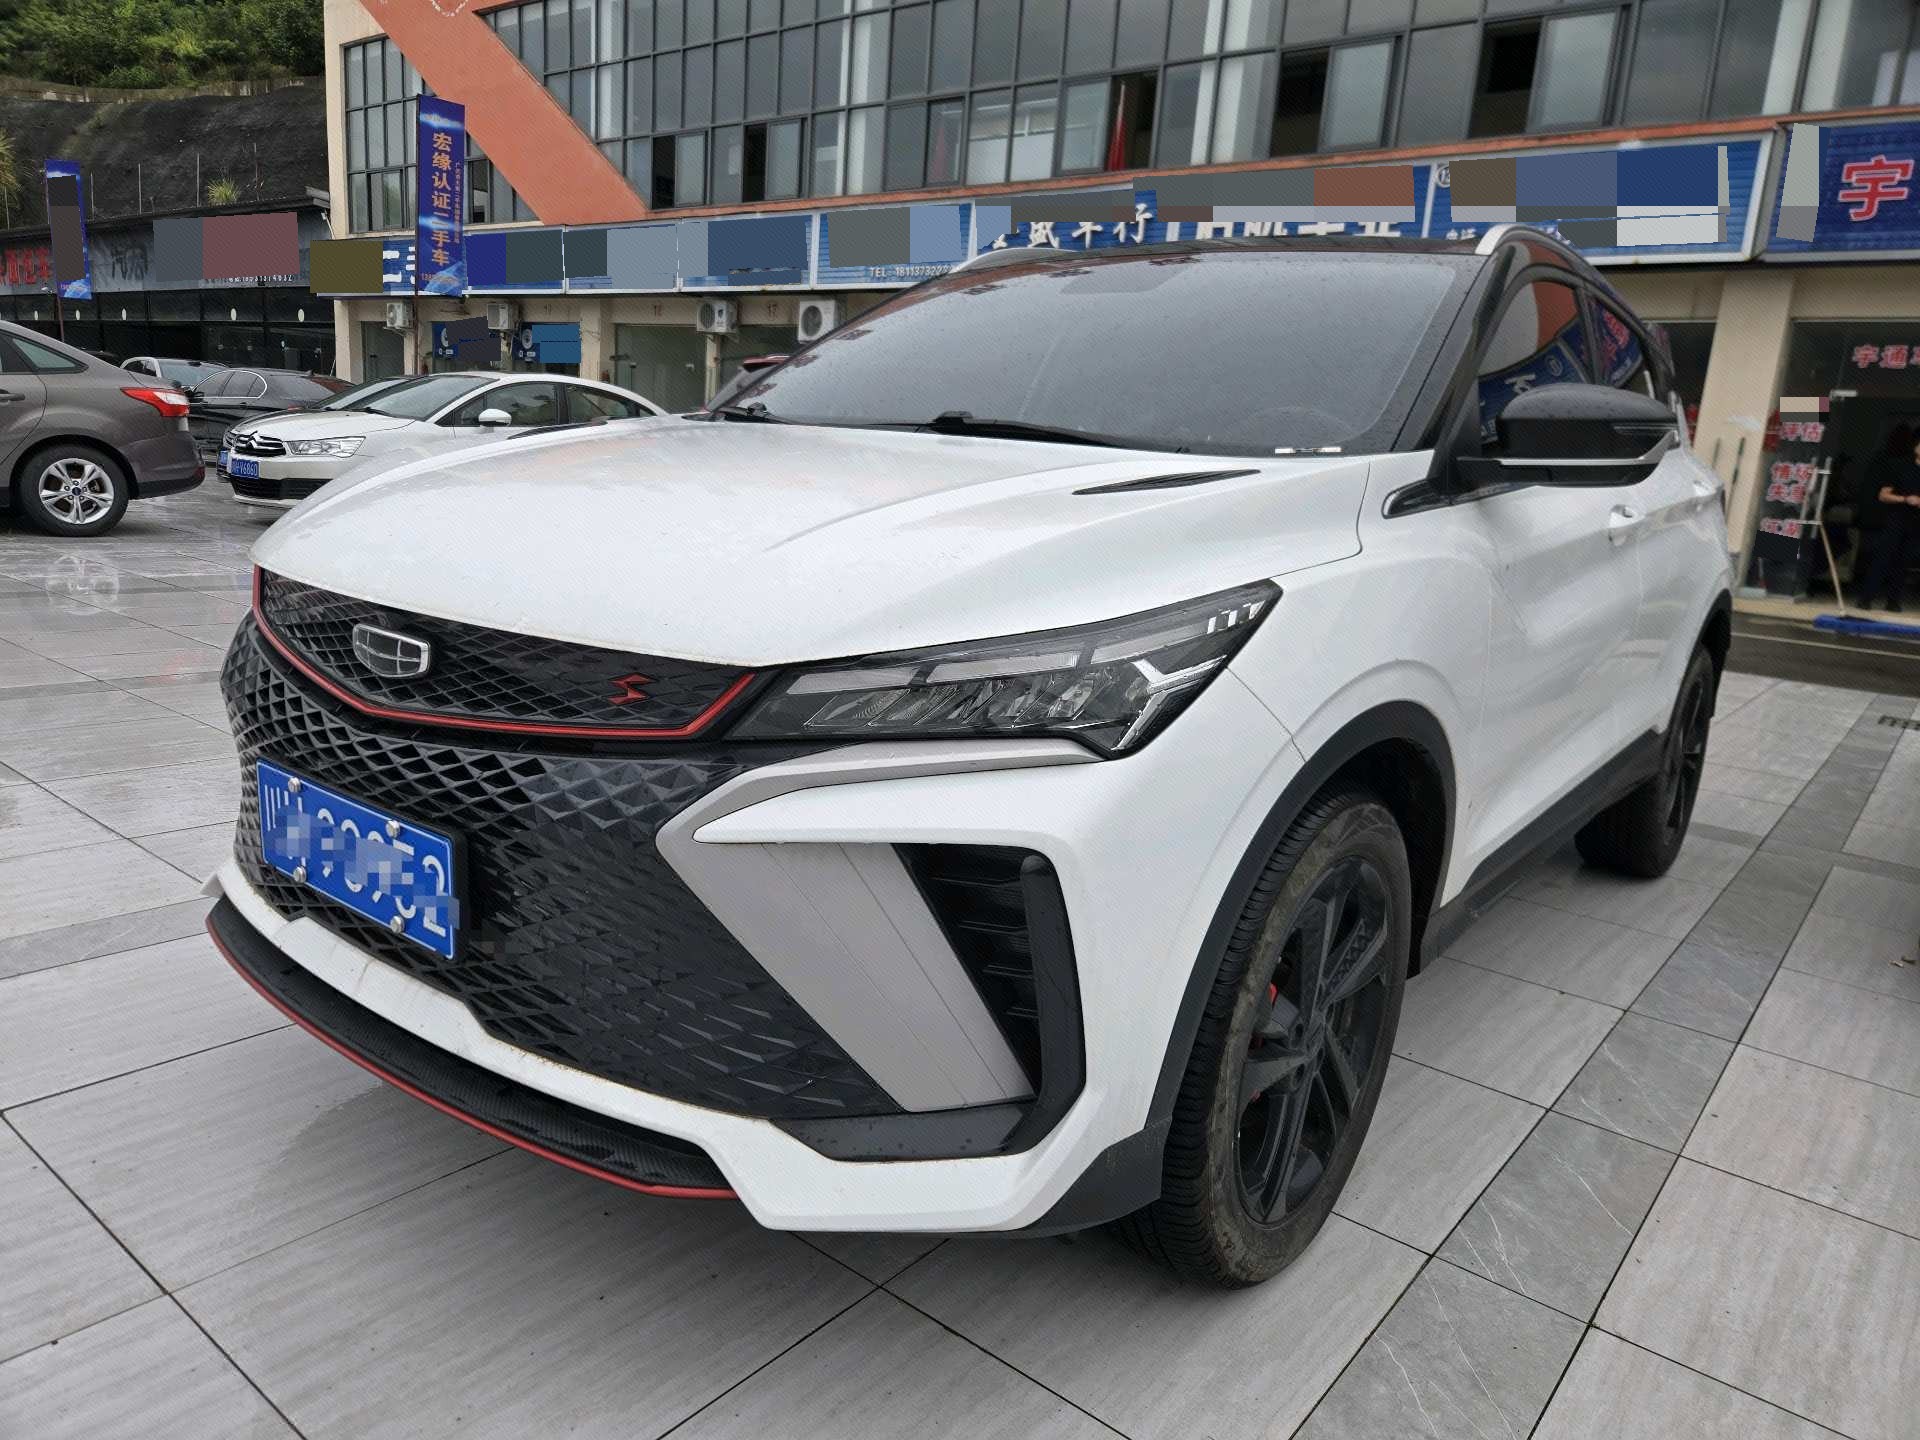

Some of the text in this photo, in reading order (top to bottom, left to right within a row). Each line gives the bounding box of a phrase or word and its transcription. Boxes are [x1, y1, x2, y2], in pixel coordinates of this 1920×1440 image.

[431, 132, 453, 266] 宏缘认证二手车
[1838, 154, 1915, 222] 宇
[1851, 343, 1920, 369] 宇通
